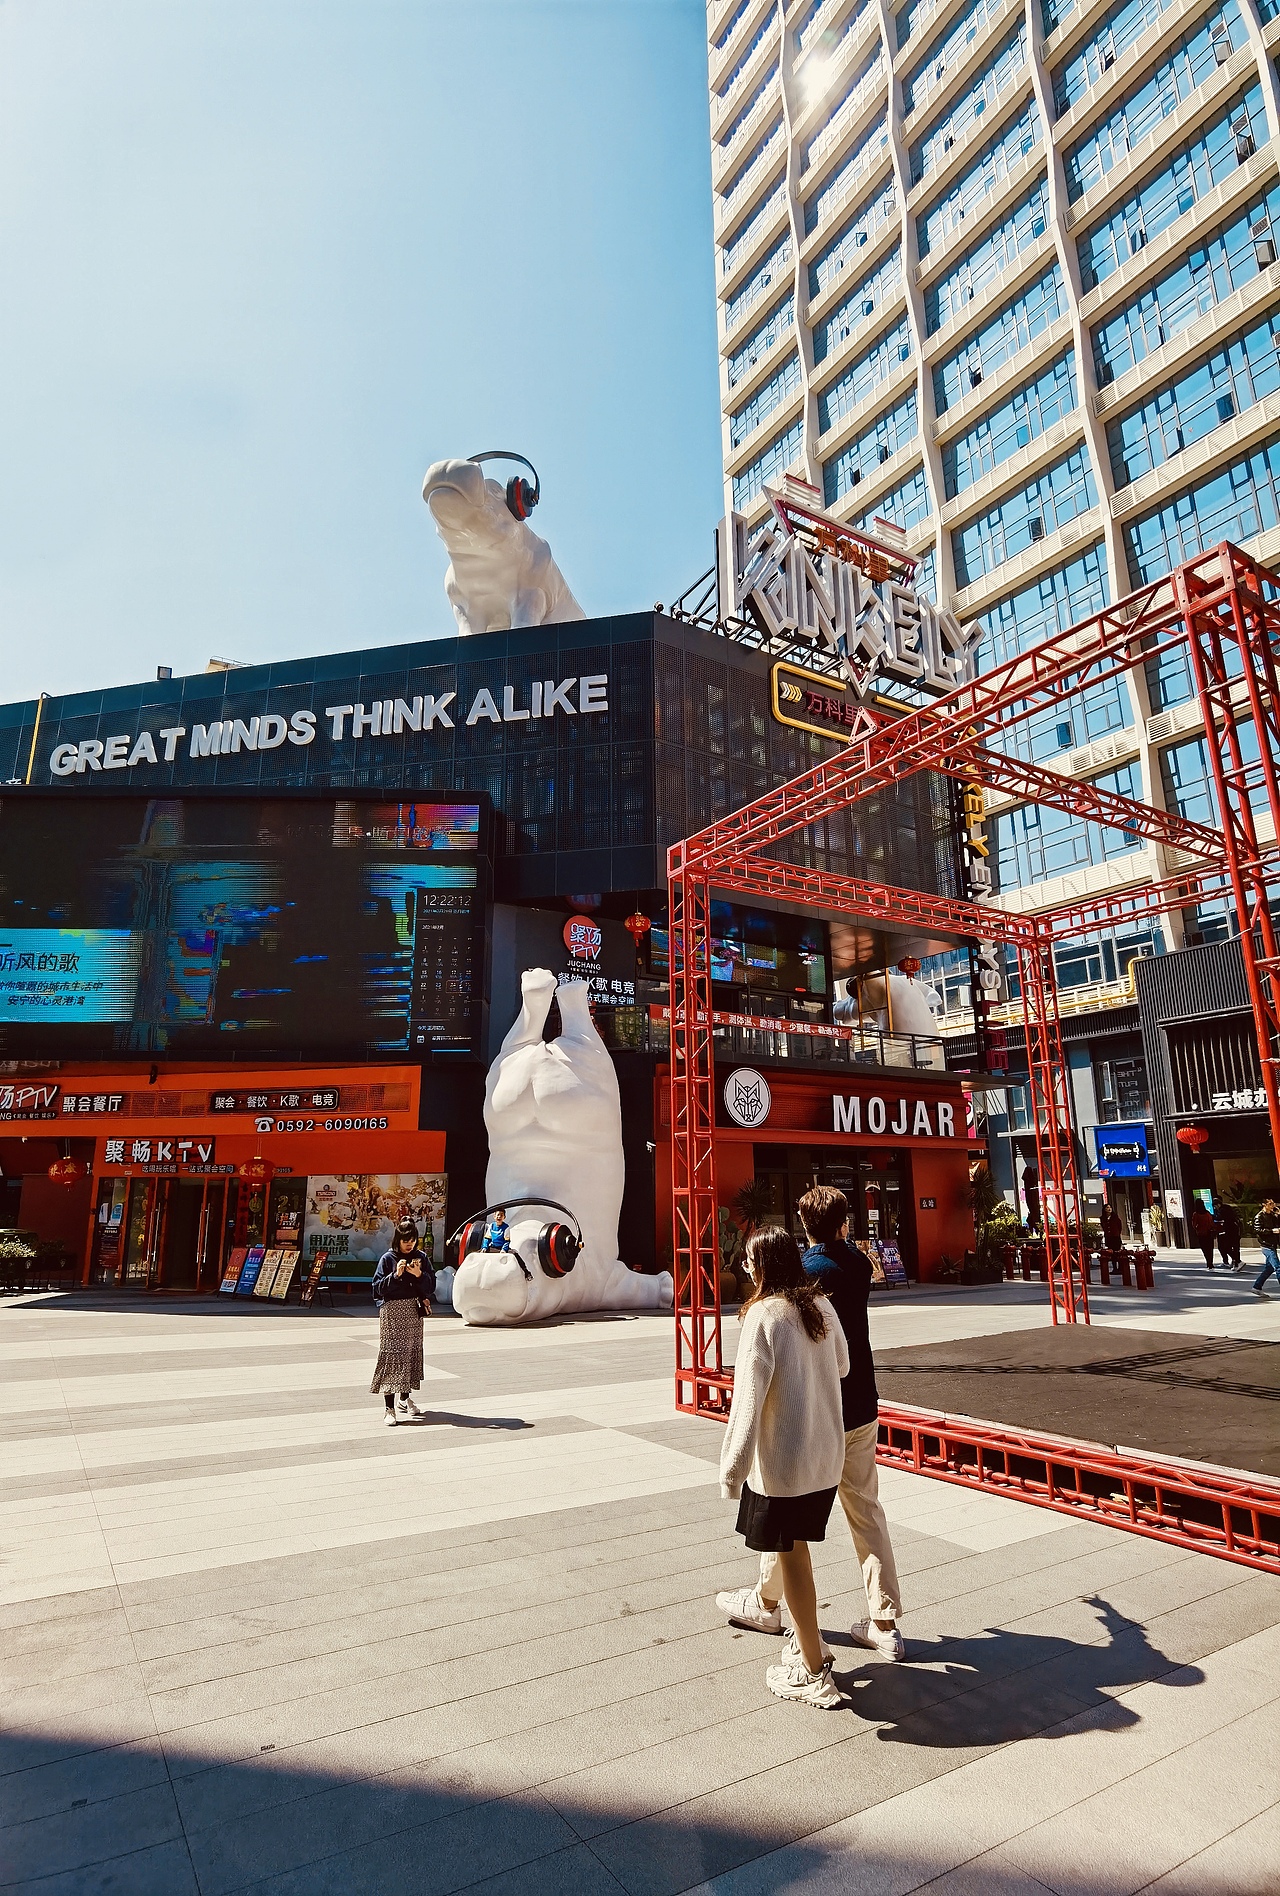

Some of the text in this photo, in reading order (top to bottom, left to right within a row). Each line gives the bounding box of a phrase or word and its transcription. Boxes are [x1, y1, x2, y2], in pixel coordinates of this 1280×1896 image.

[805, 691, 857, 725] 万科里
[49, 674, 609, 776] GREAT MINDS THINK ALIKE
[423, 894, 472, 906] 12:22:12
[570, 944, 602, 961] PTV
[0, 952, 80, 973] 听风的歌
[566, 959, 602, 971] JUCHANG
[586, 976, 608, 992] K歌
[611, 979, 635, 995] 电竞
[16, 1086, 58, 1109] PTV
[62, 1095, 123, 1113] 聚会餐厅
[312, 1093, 334, 1106] 电竞
[276, 1117, 388, 1132] 0592-6090165
[832, 1094, 955, 1137] MOJAR
